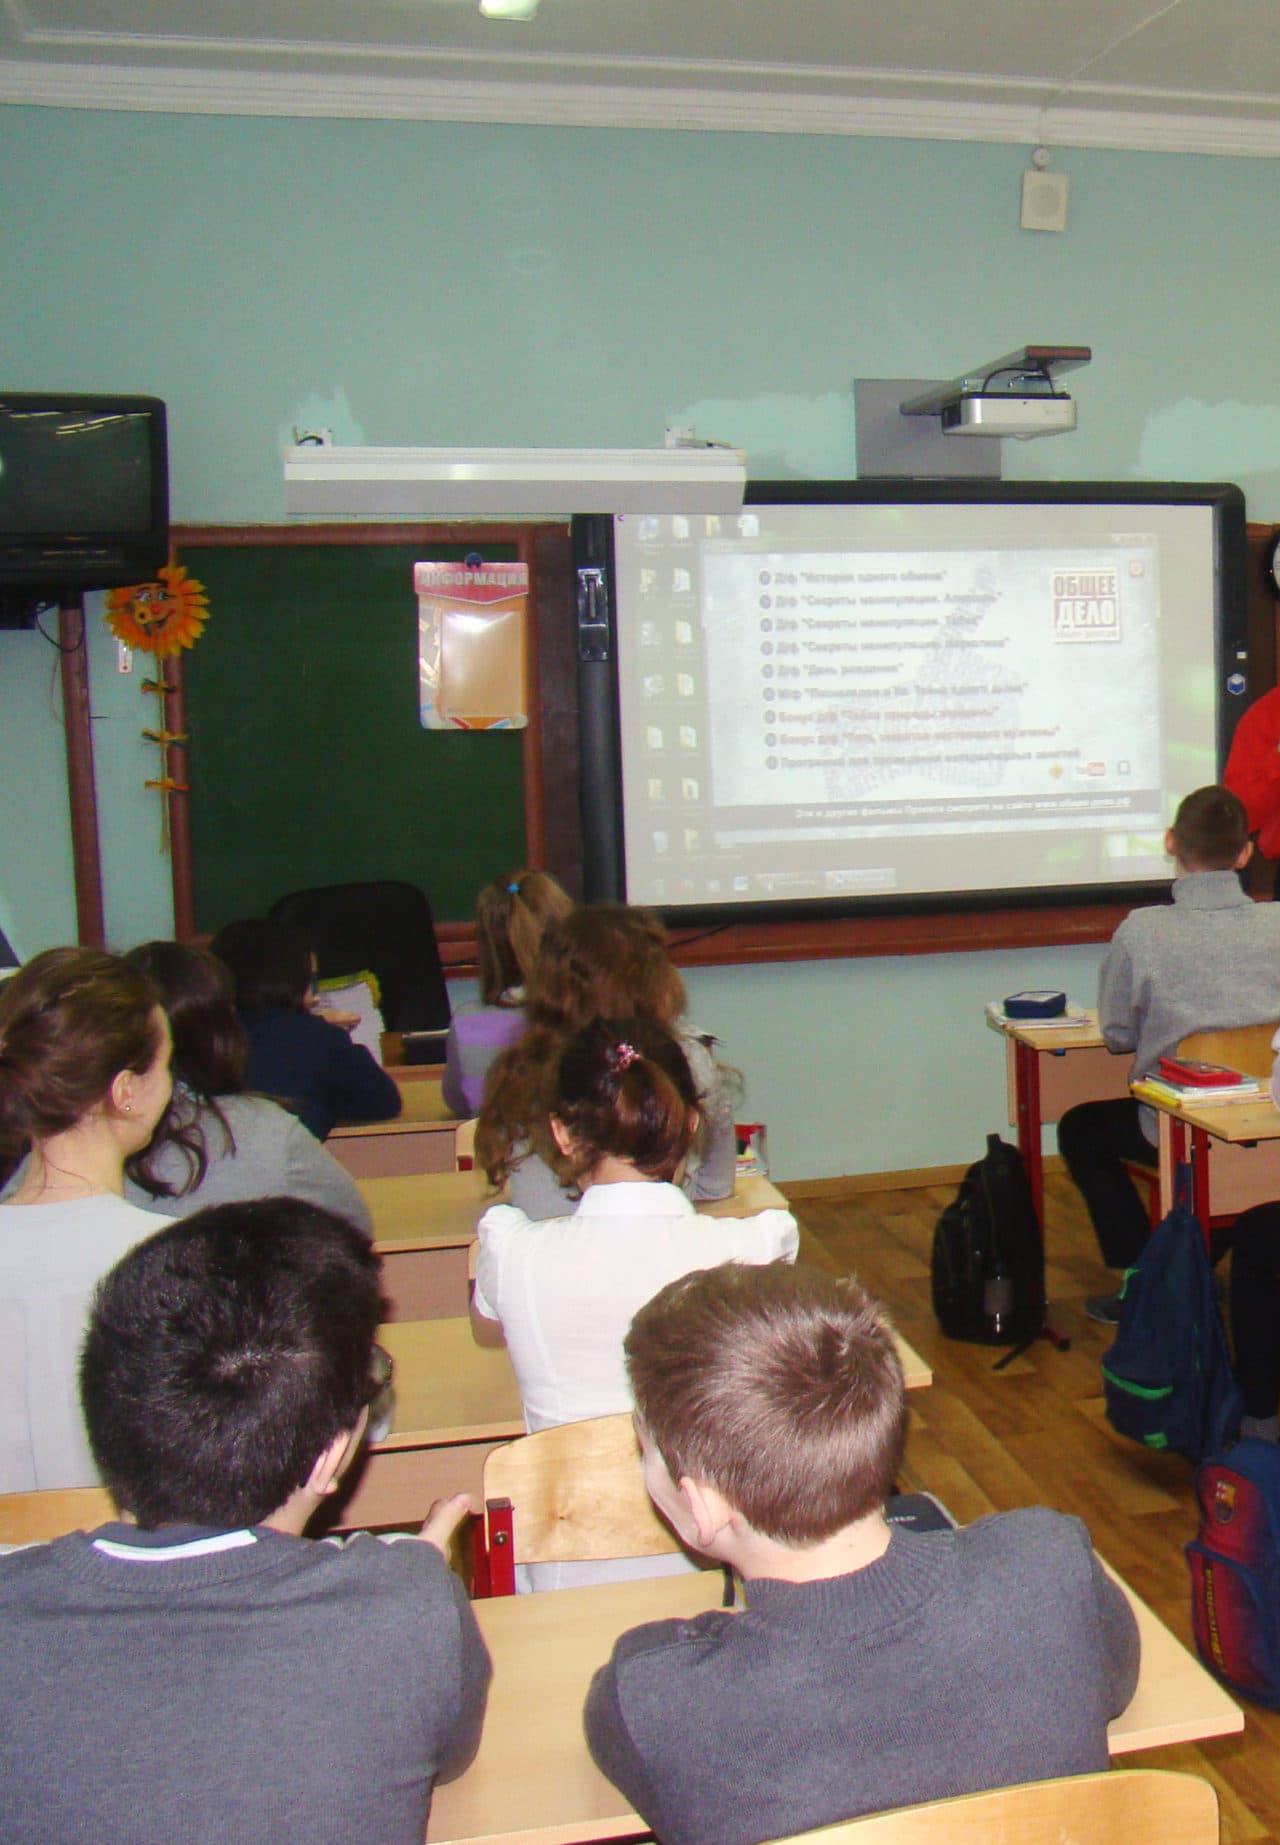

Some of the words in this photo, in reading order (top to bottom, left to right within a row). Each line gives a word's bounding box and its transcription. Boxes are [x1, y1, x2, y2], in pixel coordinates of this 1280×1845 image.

[421, 571, 528, 588] ИНФОРМАЦИЯ
[1055, 575, 1117, 597] ОБЩЕЕ
[1056, 600, 1115, 628] ДЕЛО
